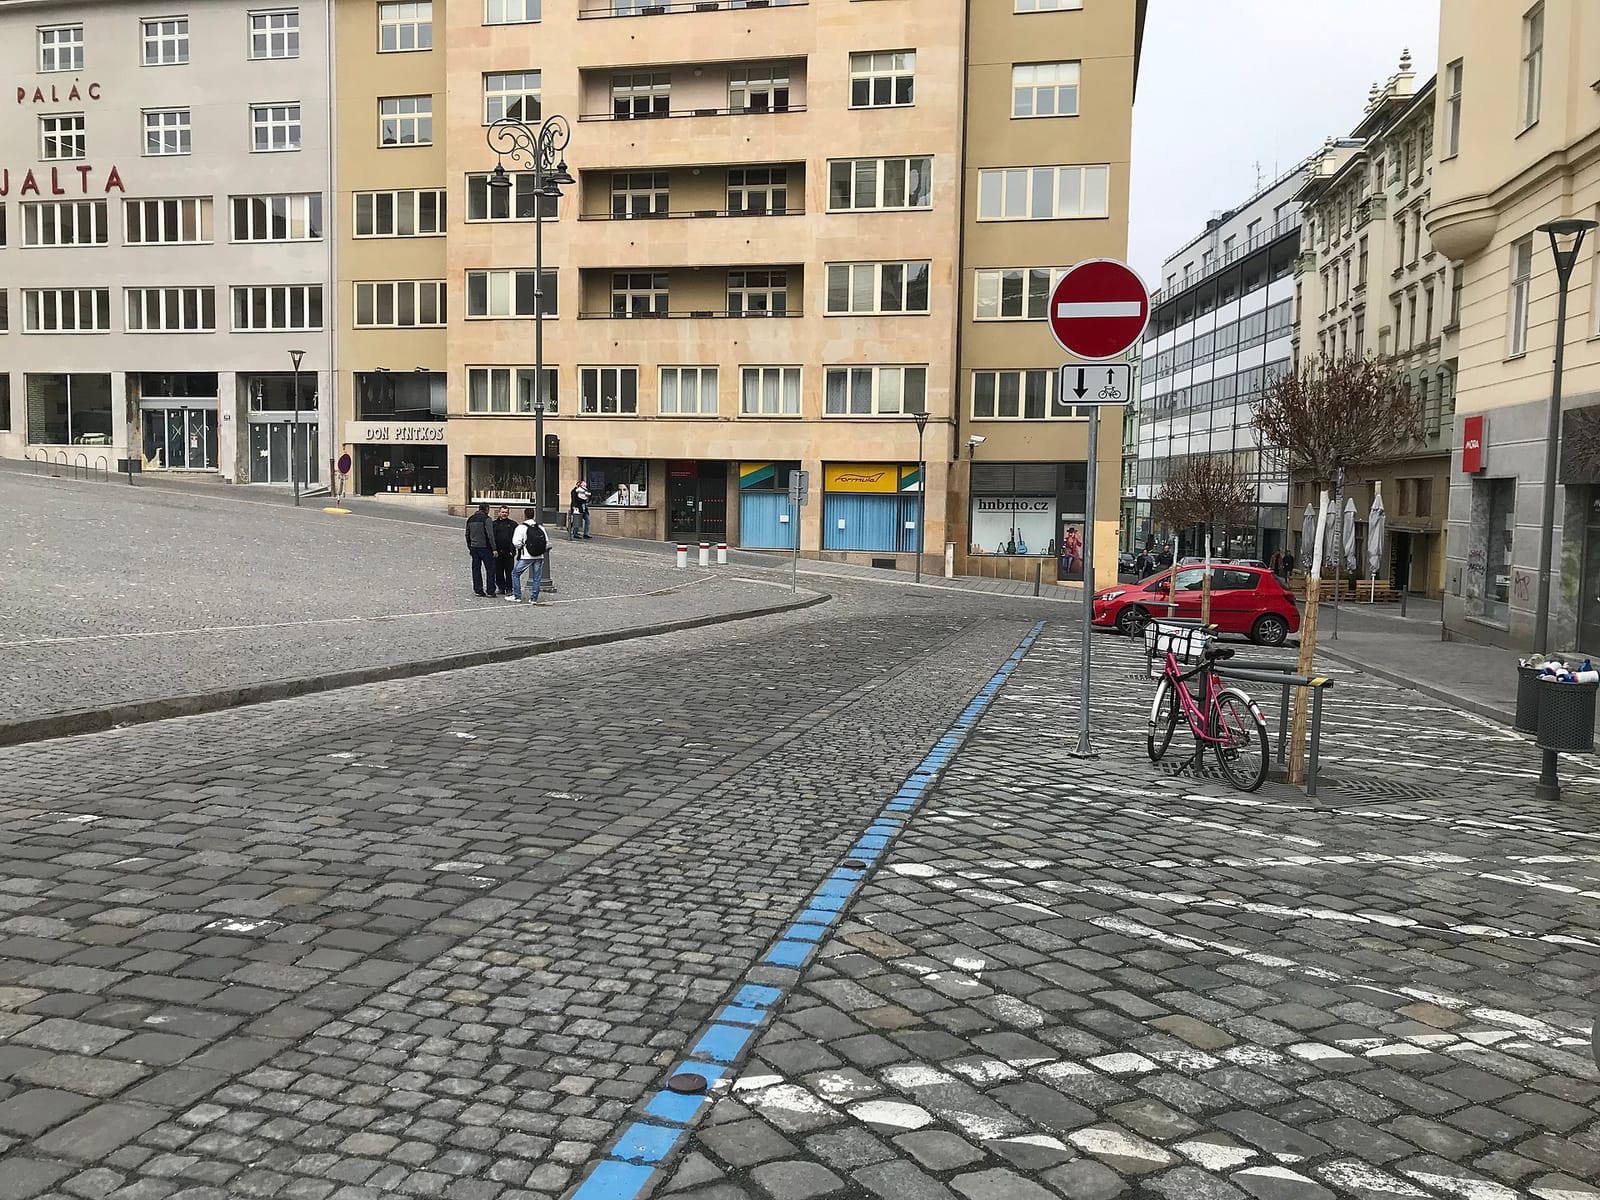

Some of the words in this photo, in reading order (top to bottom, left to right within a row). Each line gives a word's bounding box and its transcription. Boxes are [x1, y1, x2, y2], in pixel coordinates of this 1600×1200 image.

[17, 77, 101, 104] PALÁC
[0, 165, 126, 196] JALTA
[366, 426, 389, 440] DON
[395, 426, 444, 441] PINTXOS
[978, 498, 1049, 511] hnbrno.cz
